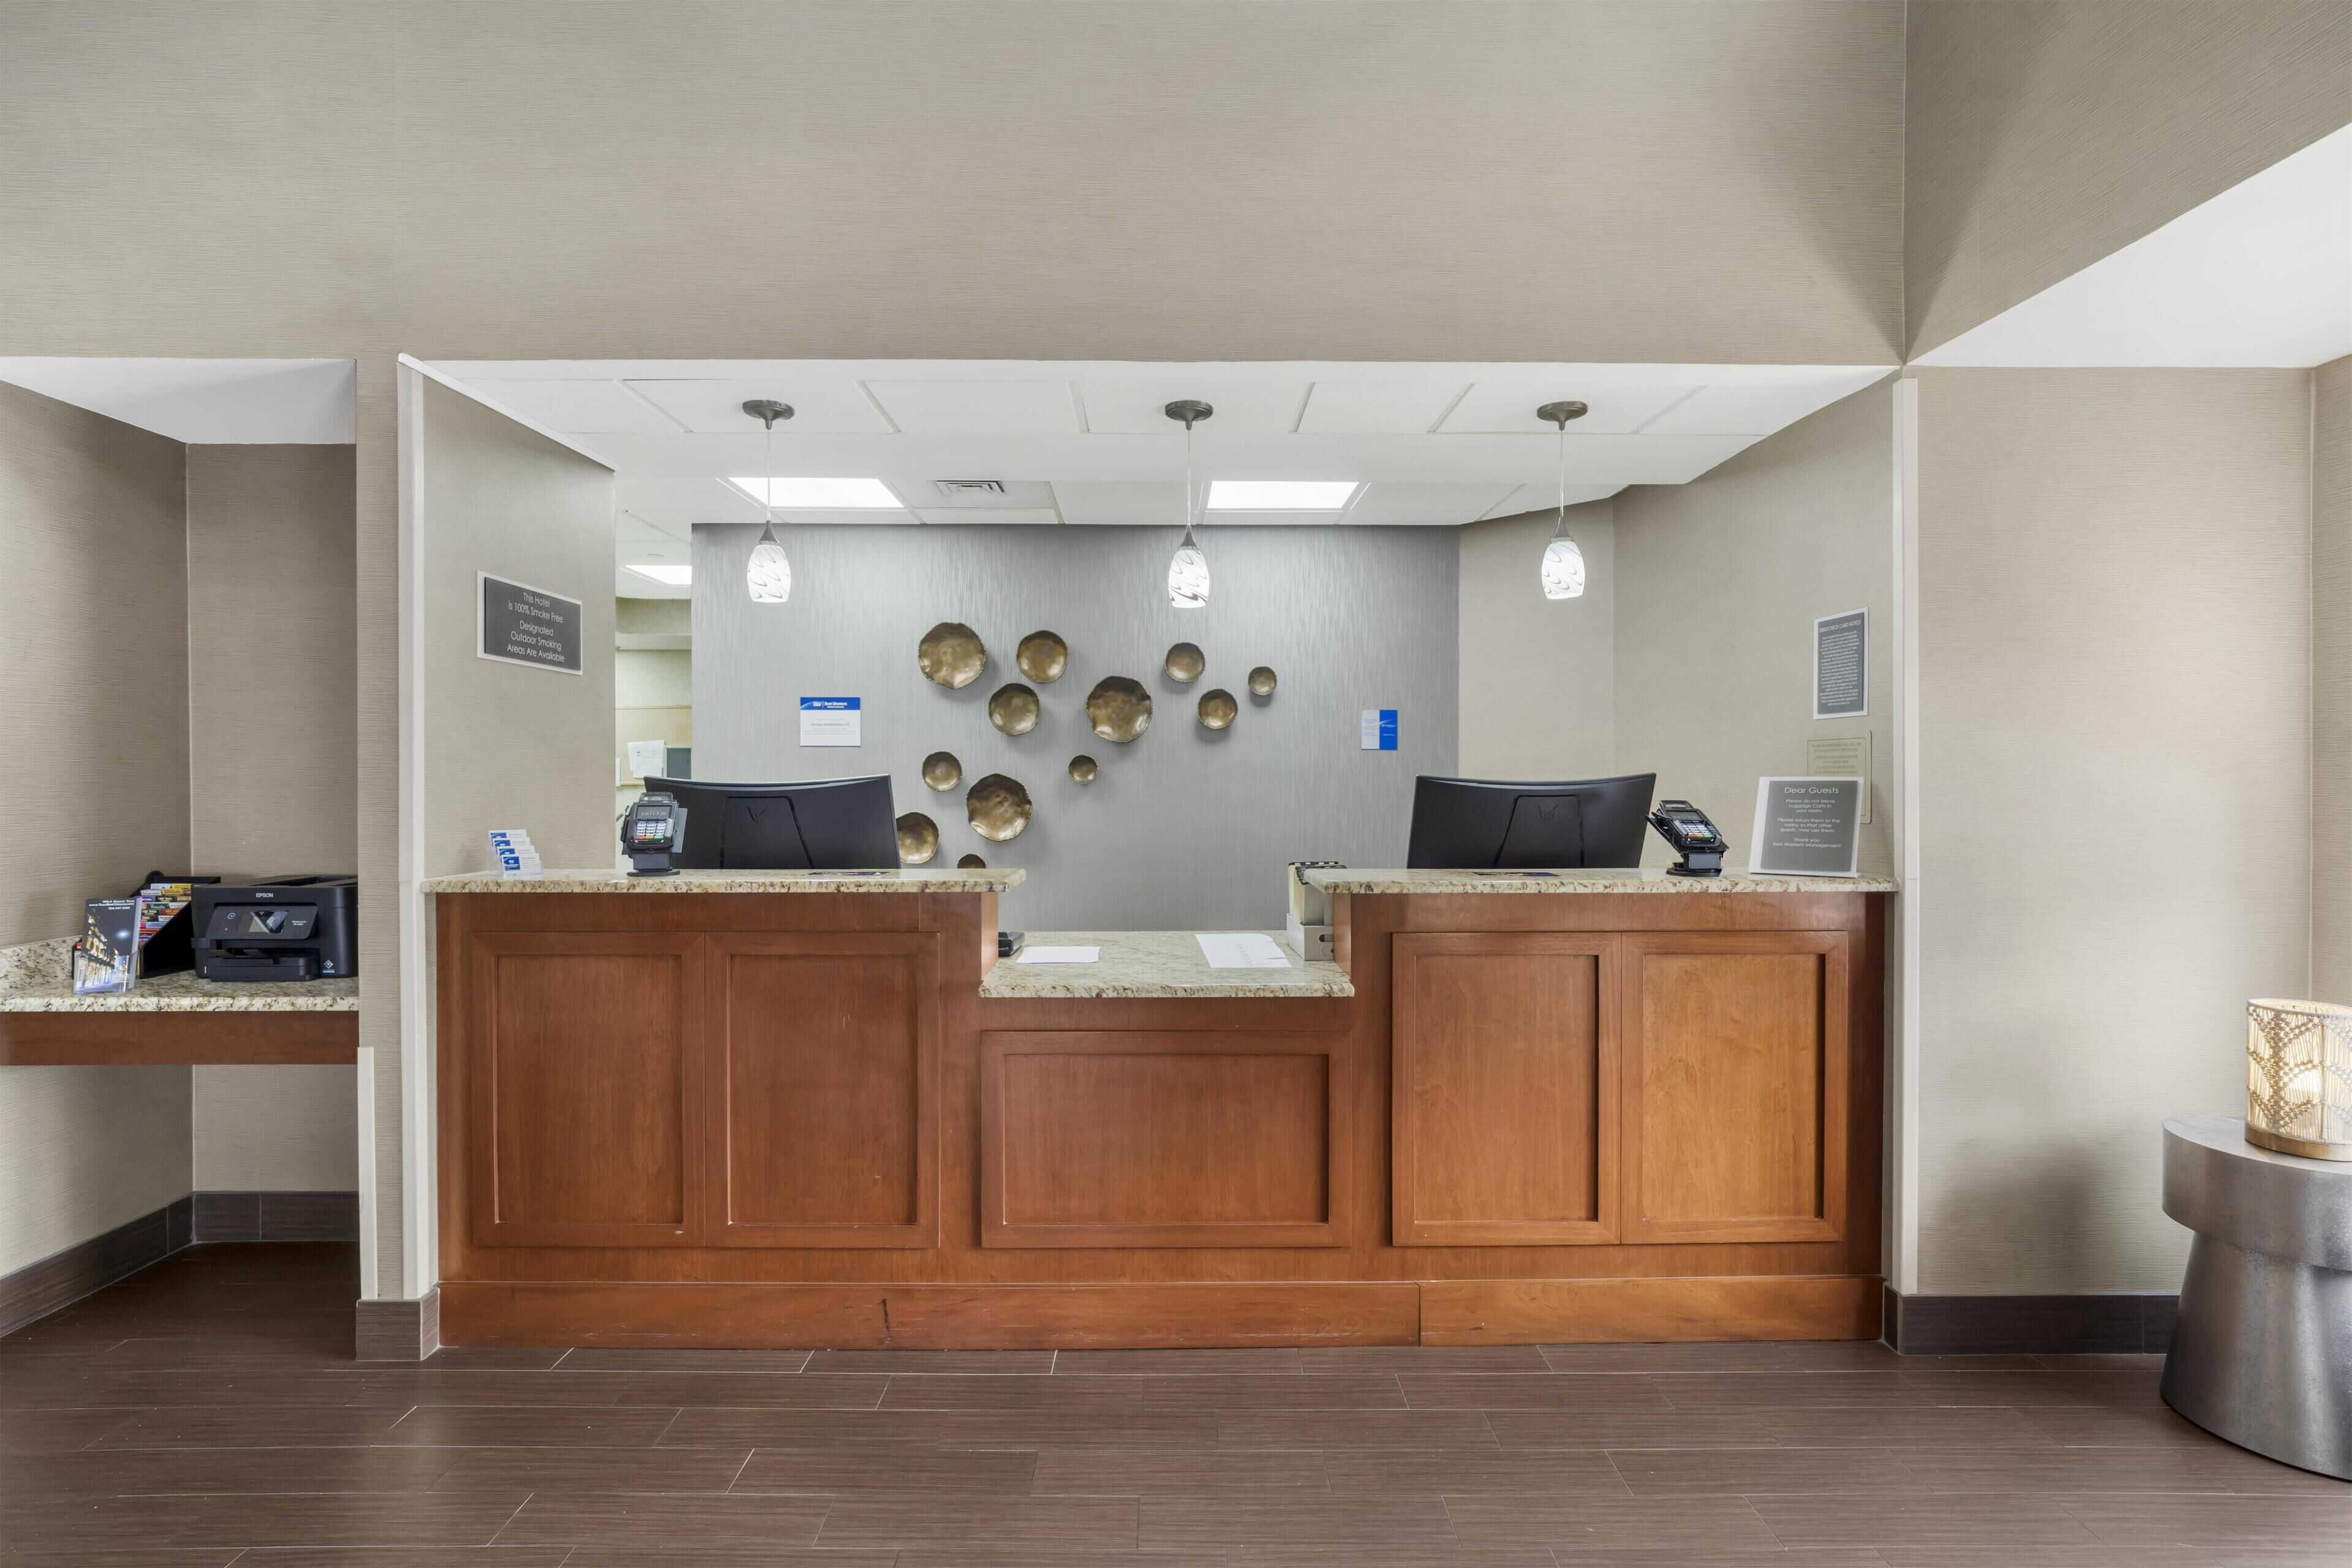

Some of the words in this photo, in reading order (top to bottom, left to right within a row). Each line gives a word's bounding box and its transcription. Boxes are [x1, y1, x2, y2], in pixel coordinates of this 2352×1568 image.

[523, 592, 533, 603] This
[535, 595, 550, 608] Hotel
[508, 600, 513, 610] is
[514, 602, 530, 615] 100%
[530, 606, 550, 619] Smoke
[551, 612, 563, 623] Free
[519, 620, 554, 636] Designated
[510, 631, 537, 644] Outdoor
[538, 637, 561, 652] Smoking
[507, 643, 525, 655] Areas
[526, 647, 537, 657] Are
[538, 649, 565, 662] Available
